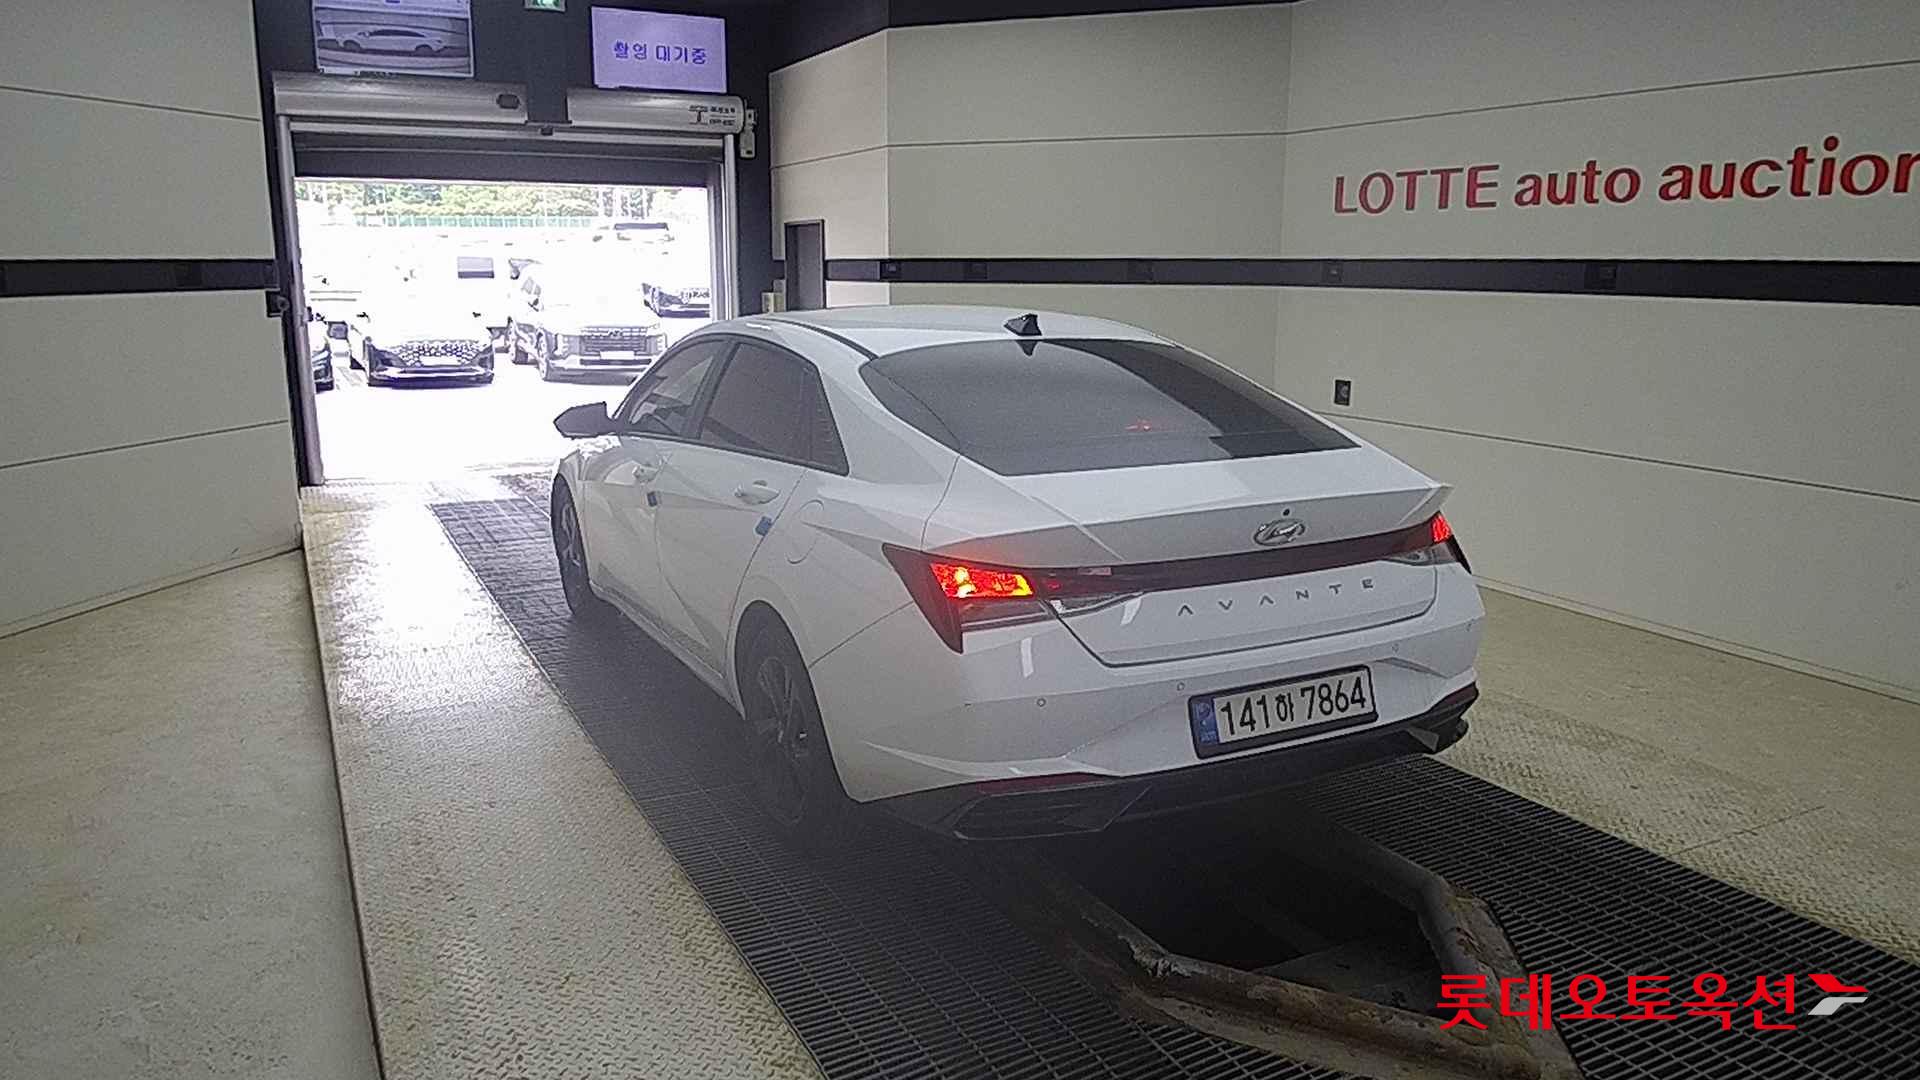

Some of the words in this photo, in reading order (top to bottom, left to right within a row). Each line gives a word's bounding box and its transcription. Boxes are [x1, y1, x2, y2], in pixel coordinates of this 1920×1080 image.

[655, 44, 707, 64] 대기중
[1333, 164, 1500, 213] LOTTE
[1514, 160, 1641, 206] auto
[1178, 578, 1375, 617] AVANTE
[1300, 676, 1367, 720] 7864
